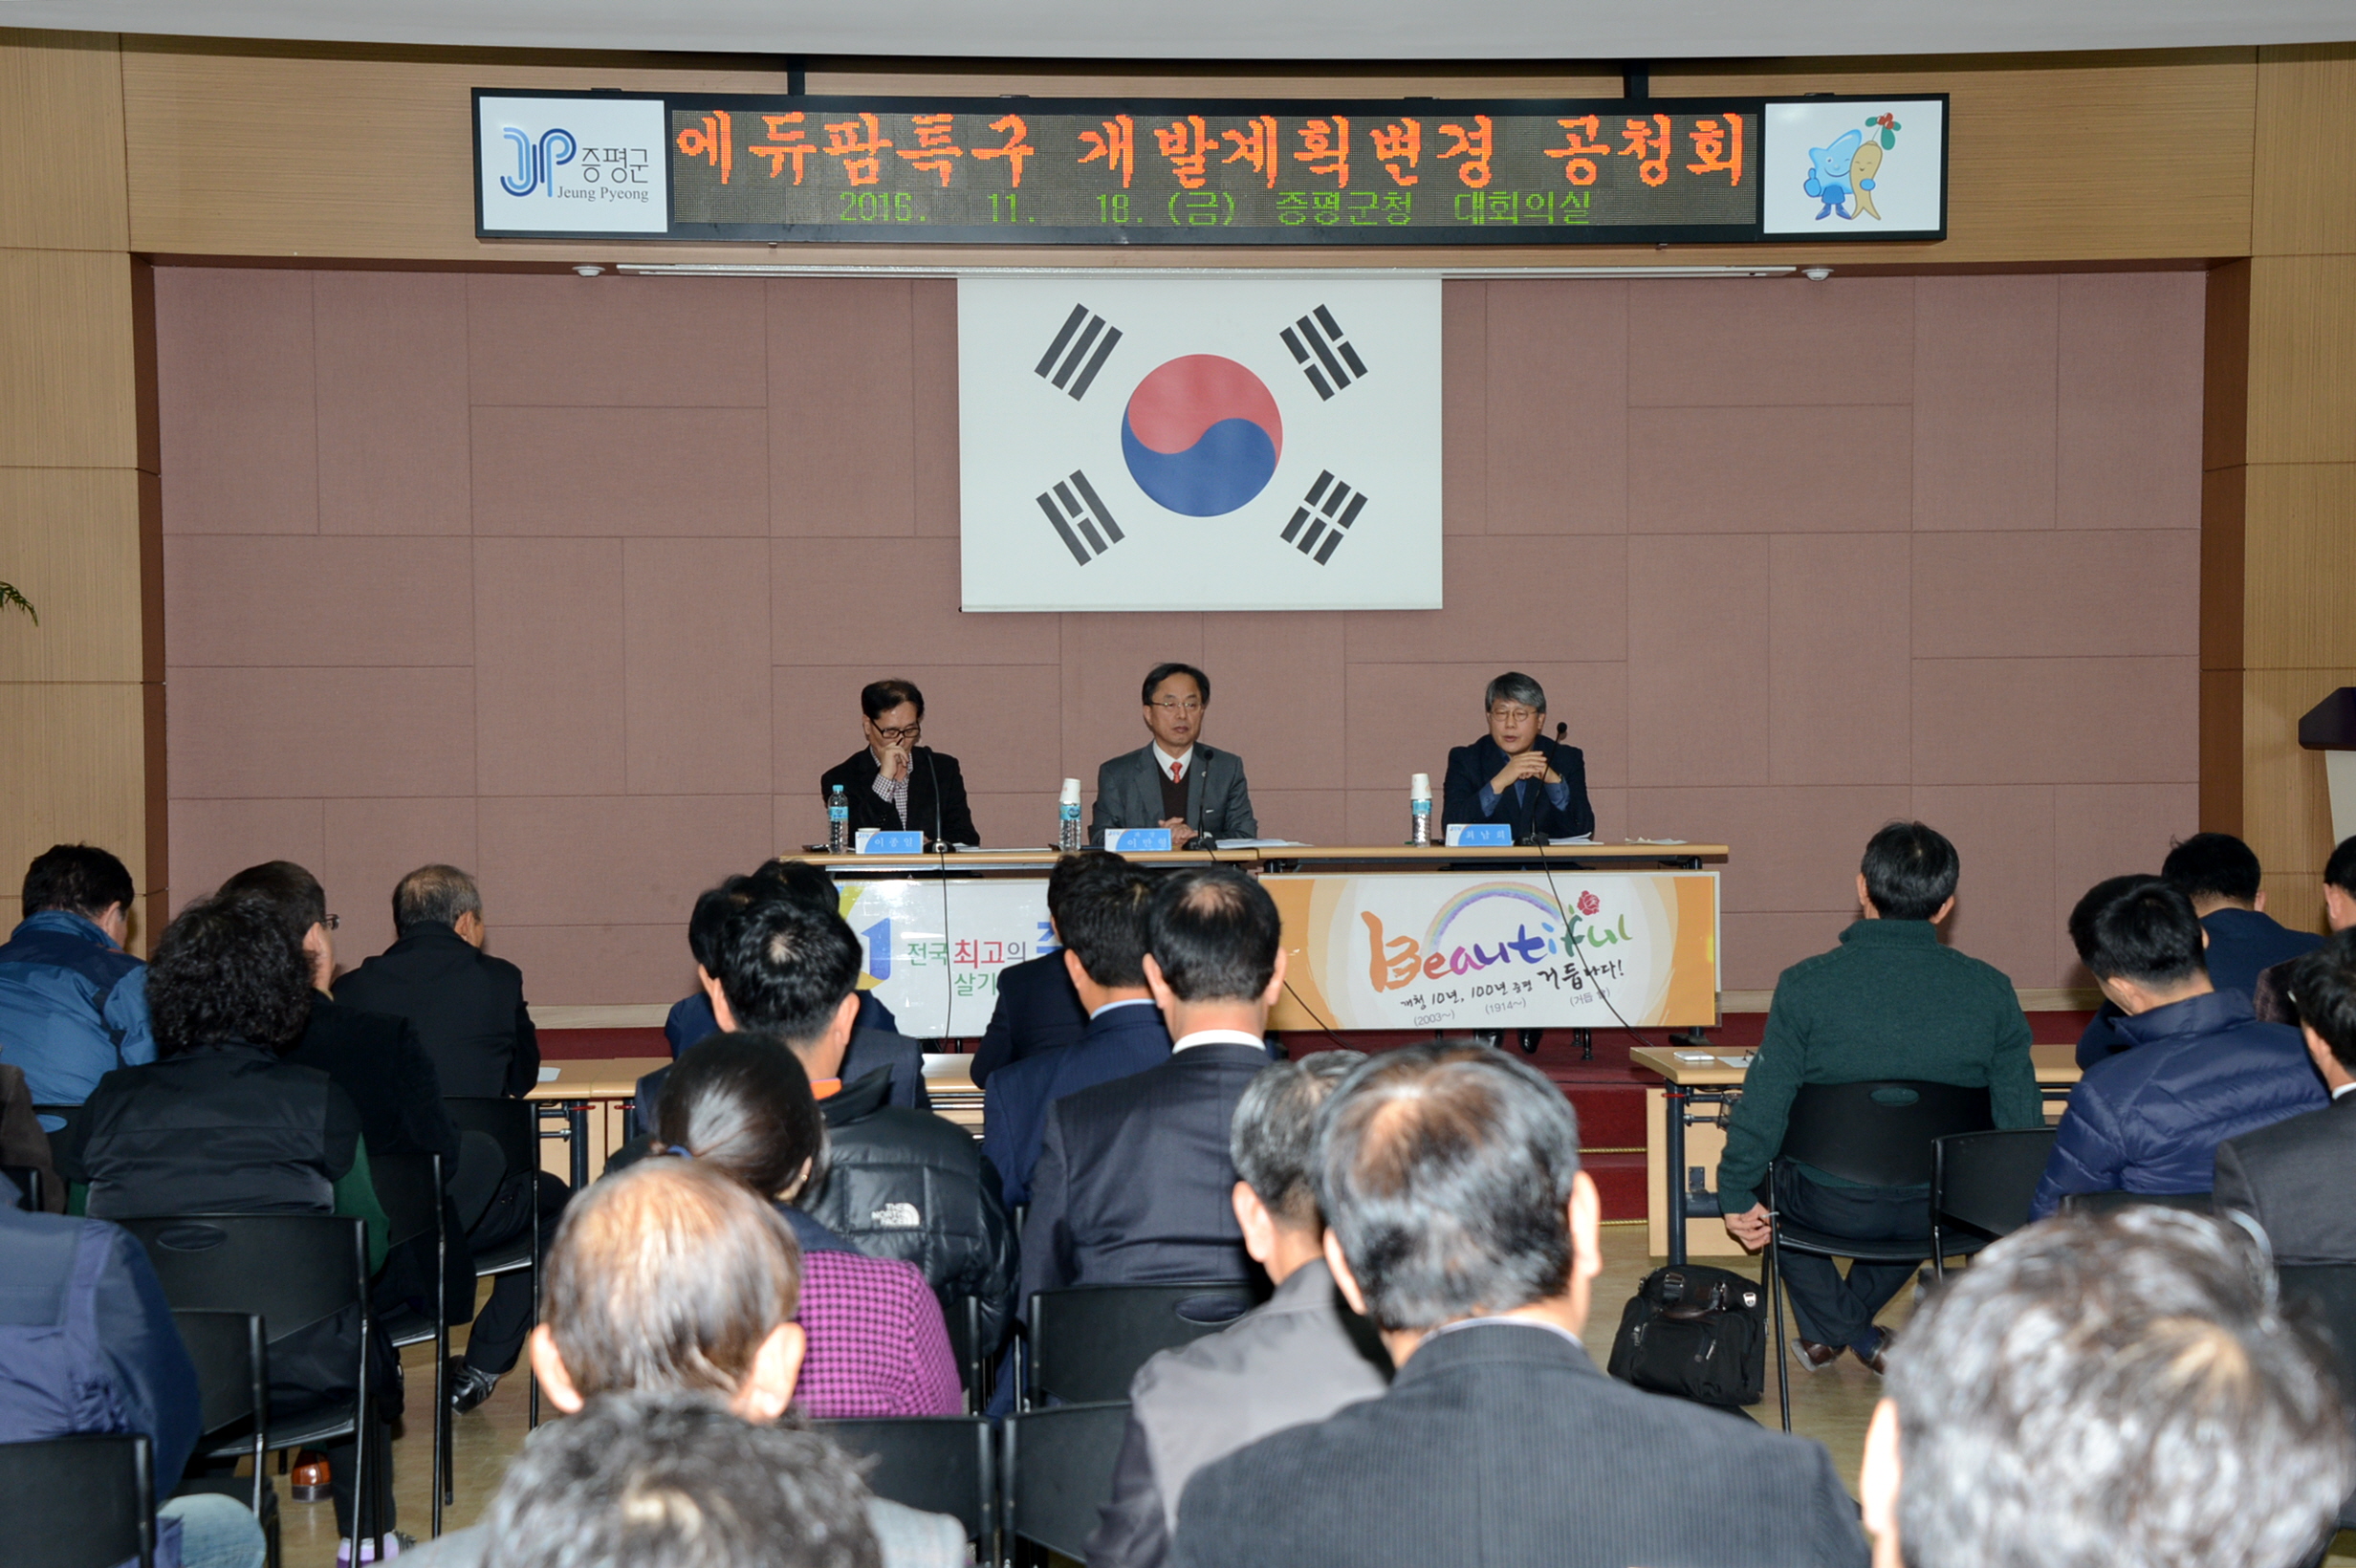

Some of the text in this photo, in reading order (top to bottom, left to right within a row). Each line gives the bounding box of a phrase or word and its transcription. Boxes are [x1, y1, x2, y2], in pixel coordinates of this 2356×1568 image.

[581, 147, 649, 184] 증평군
[1543, 112, 1744, 186] 공청회
[557, 186, 649, 203] Jeung Pyeong
[988, 193, 1036, 222] 11.
[1097, 193, 1144, 223] 18.
[1167, 191, 1235, 225] (금)
[1275, 190, 1413, 225] 증평군청
[1453, 190, 1591, 225] 대회의실
[907, 939, 1026, 969] 전국 최고의
[1361, 909, 1633, 993] Beautiful
[1471, 981, 1508, 998] 100년
